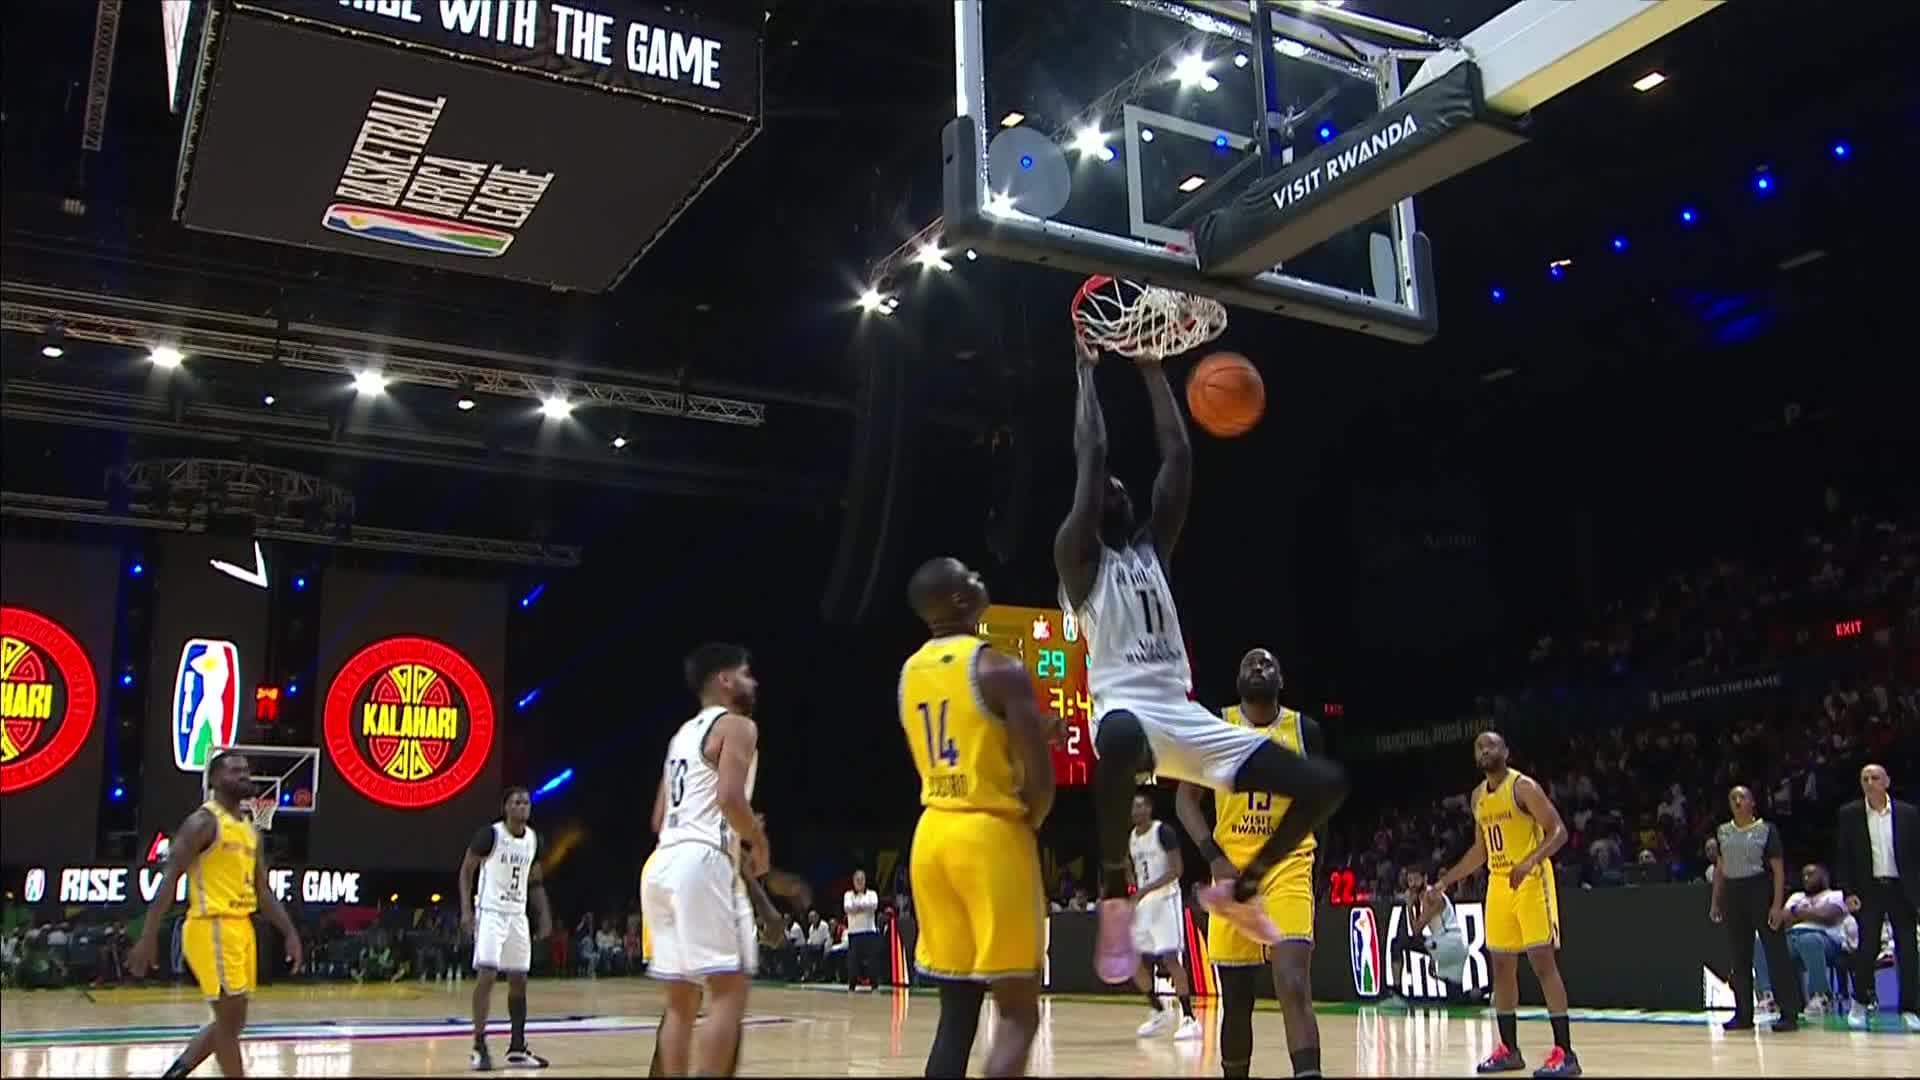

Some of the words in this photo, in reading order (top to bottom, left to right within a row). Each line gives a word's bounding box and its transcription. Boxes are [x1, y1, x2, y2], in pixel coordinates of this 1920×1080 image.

[439, 0, 538, 48] WITH
[552, 3, 617, 65] THE
[628, 22, 722, 89] GAME
[335, 89, 448, 208] BASKETBALL
[1272, 167, 1321, 210] VISIT
[1326, 113, 1417, 182] RWANDA
[401, 155, 489, 219] AFRICA
[463, 163, 556, 230] LEAGUE
[1136, 589, 1165, 634] 11
[1835, 620, 1862, 637] EXIT
[1037, 649, 1066, 679] 29
[363, 702, 458, 740] KALAHARI
[918, 699, 959, 768] 14
[1067, 726, 1081, 754] 2
[1488, 823, 1503, 852] 10
[60, 868, 129, 903] RISE
[302, 869, 361, 904] GAME
[510, 866, 521, 890] 5
[1329, 870, 1355, 904] 22
